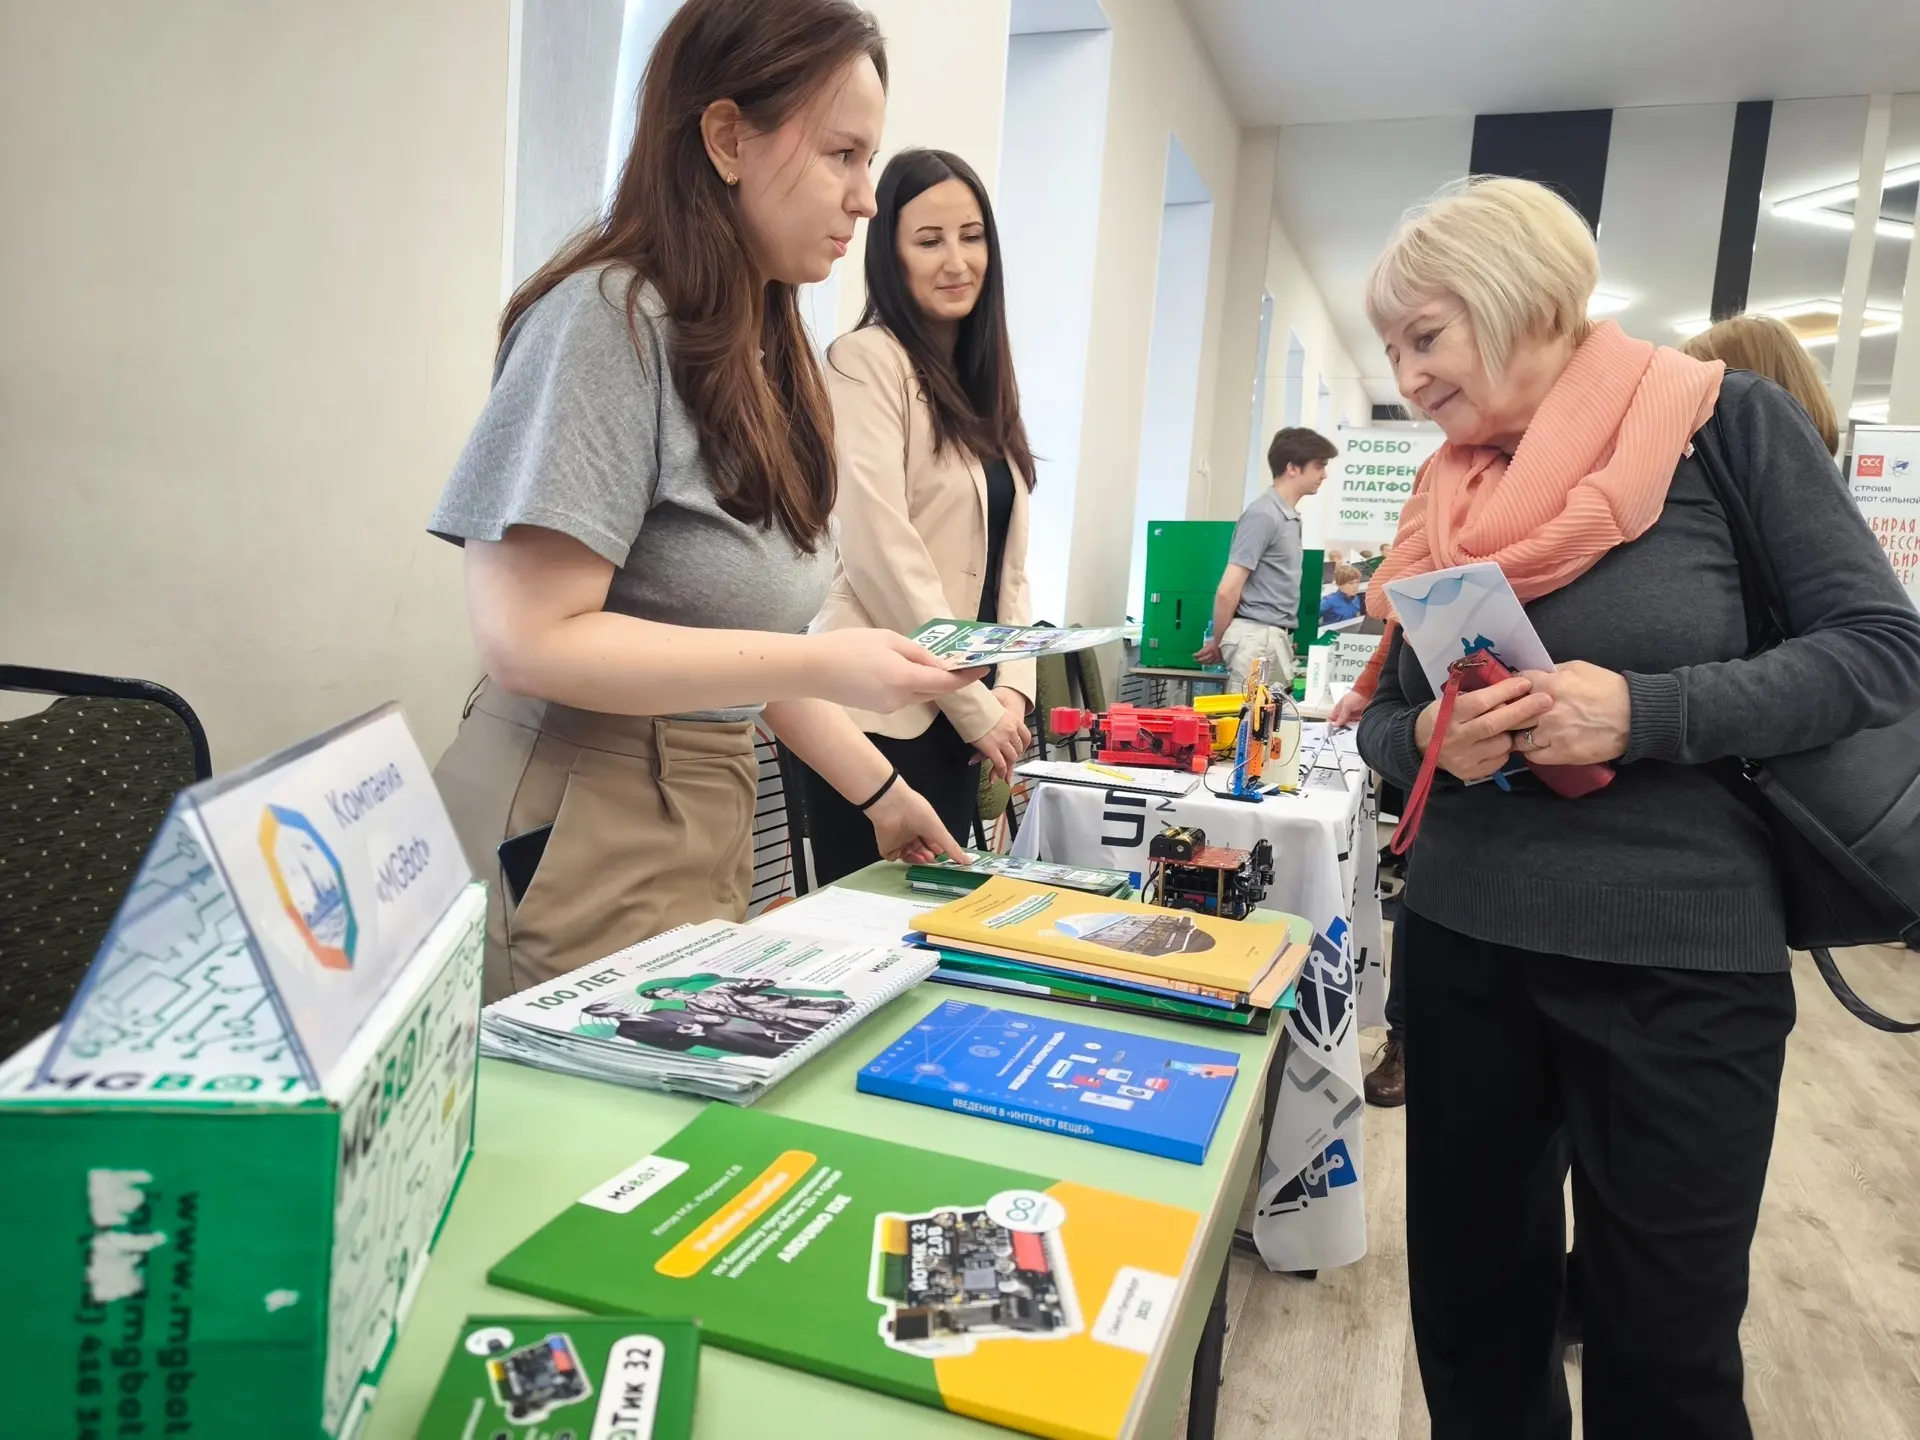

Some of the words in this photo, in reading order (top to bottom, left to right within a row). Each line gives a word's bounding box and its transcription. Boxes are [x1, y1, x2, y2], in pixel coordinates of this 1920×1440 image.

[1347, 440, 1411, 453] РОББО
[1344, 464, 1417, 476] СУВЕРЕН
[1343, 480, 1412, 492] ПЛАТФО
[1341, 674, 1355, 682] 3D
[324, 762, 405, 830] Компания
[525, 990, 579, 1011] 100
[574, 968, 627, 992] ЛЕТ
[952, 1097, 998, 1116] ВВЕДЕНИЕ
[999, 1108, 1006, 1117] В
[911, 1222, 928, 1240] 32
[623, 1348, 652, 1371] 32
